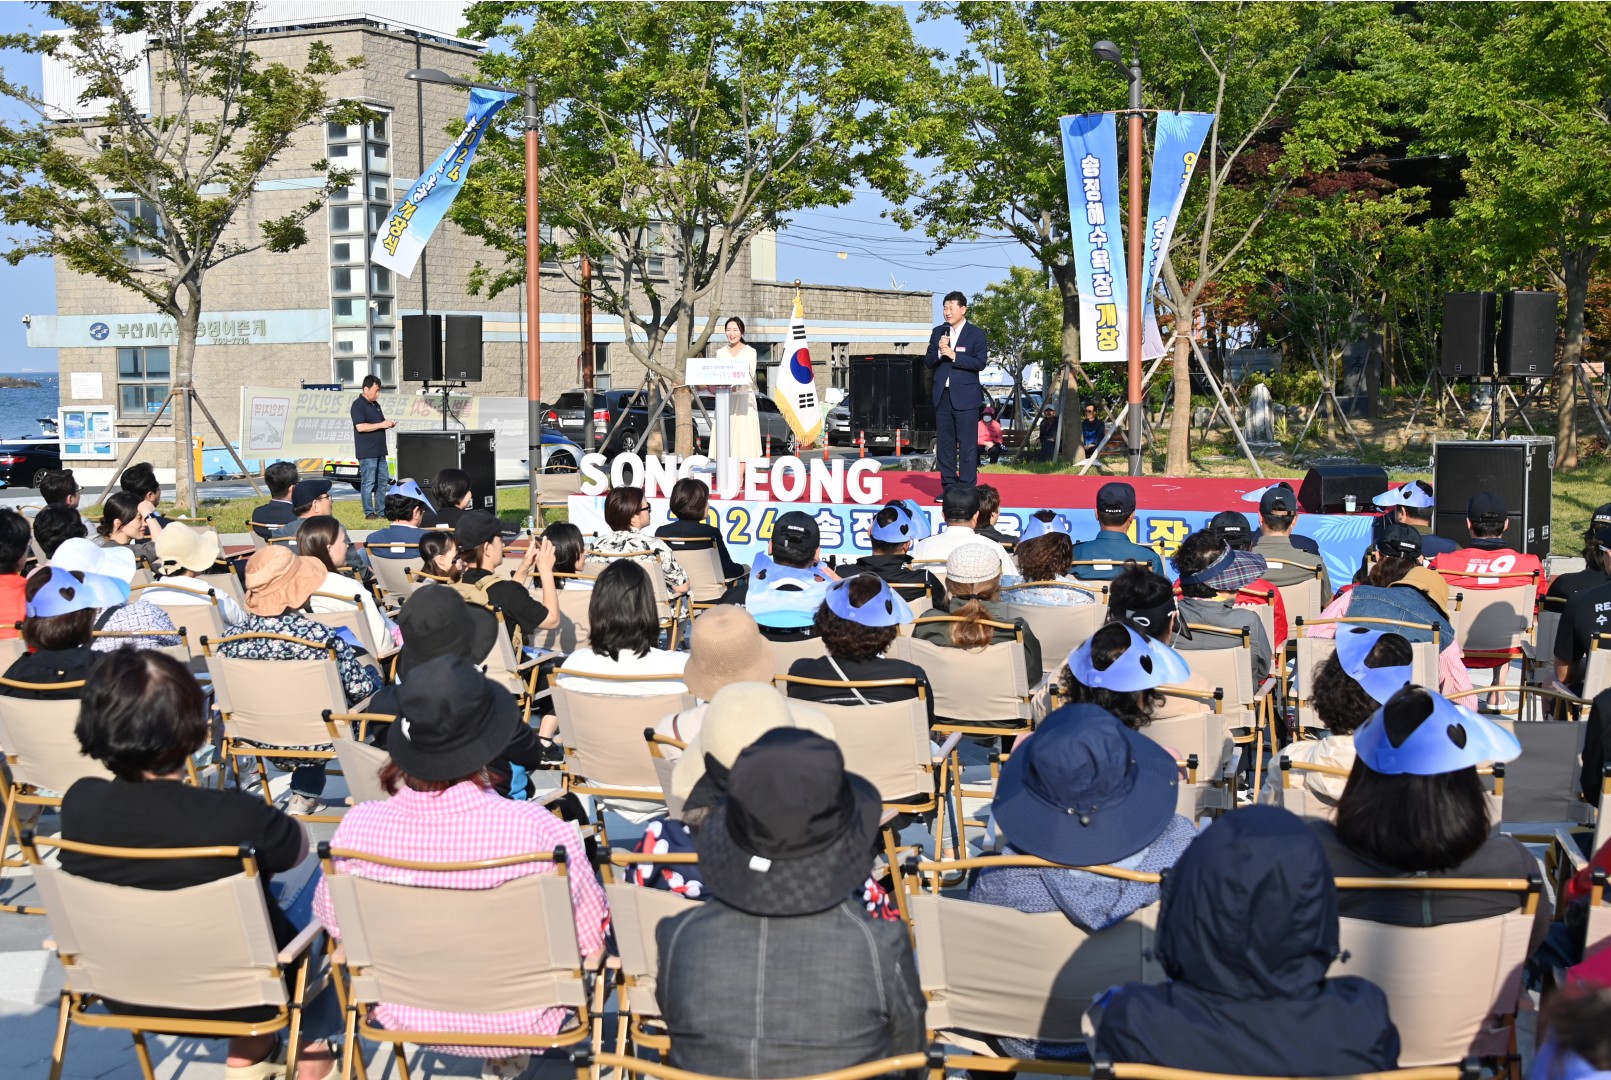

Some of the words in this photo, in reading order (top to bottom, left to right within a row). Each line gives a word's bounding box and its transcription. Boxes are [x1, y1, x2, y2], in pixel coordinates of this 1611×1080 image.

[446, 115, 488, 182] 2024
[1080, 153, 1114, 298] 송정해수욕장
[1095, 302, 1120, 352] 개장
[579, 451, 883, 505] SONGJEONG
[1465, 554, 1516, 573] 119
